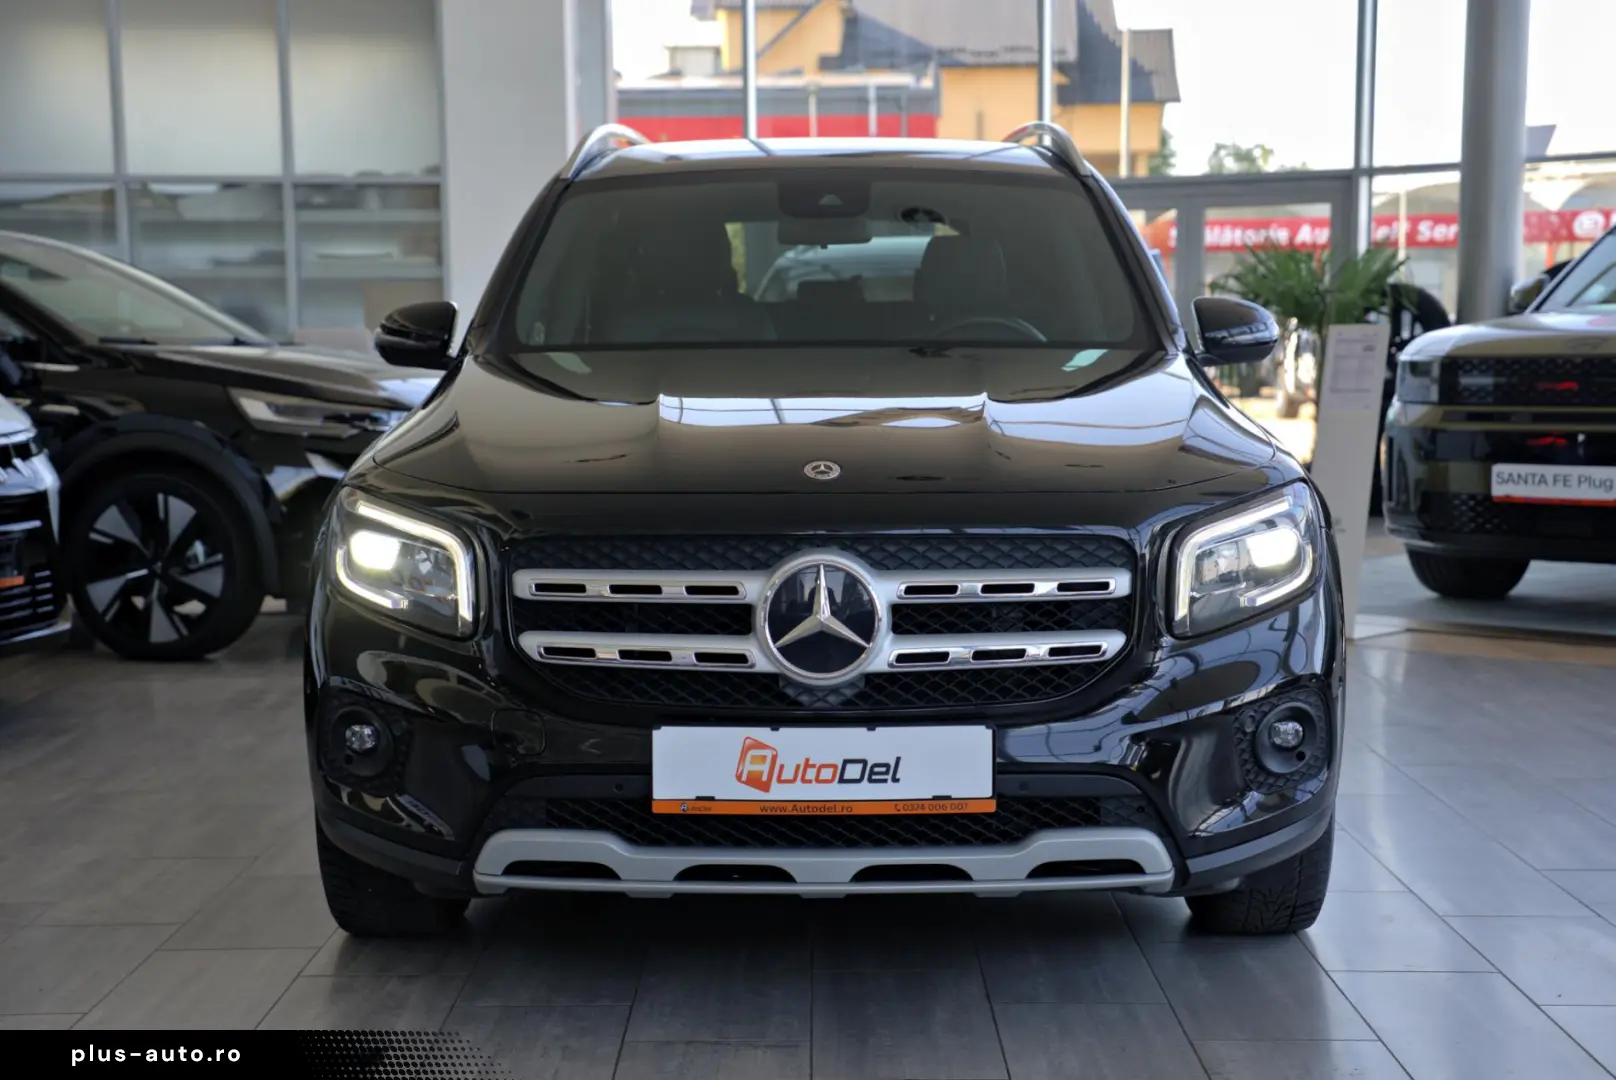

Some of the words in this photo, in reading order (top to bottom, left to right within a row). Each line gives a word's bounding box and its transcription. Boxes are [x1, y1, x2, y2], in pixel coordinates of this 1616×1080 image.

[1496, 471, 1548, 488] SANTA
[1552, 473, 1573, 488] FE
[1577, 475, 1614, 493] Plug
[739, 746, 901, 787] AutoDel
[759, 803, 853, 813] www.Autodel.ro
